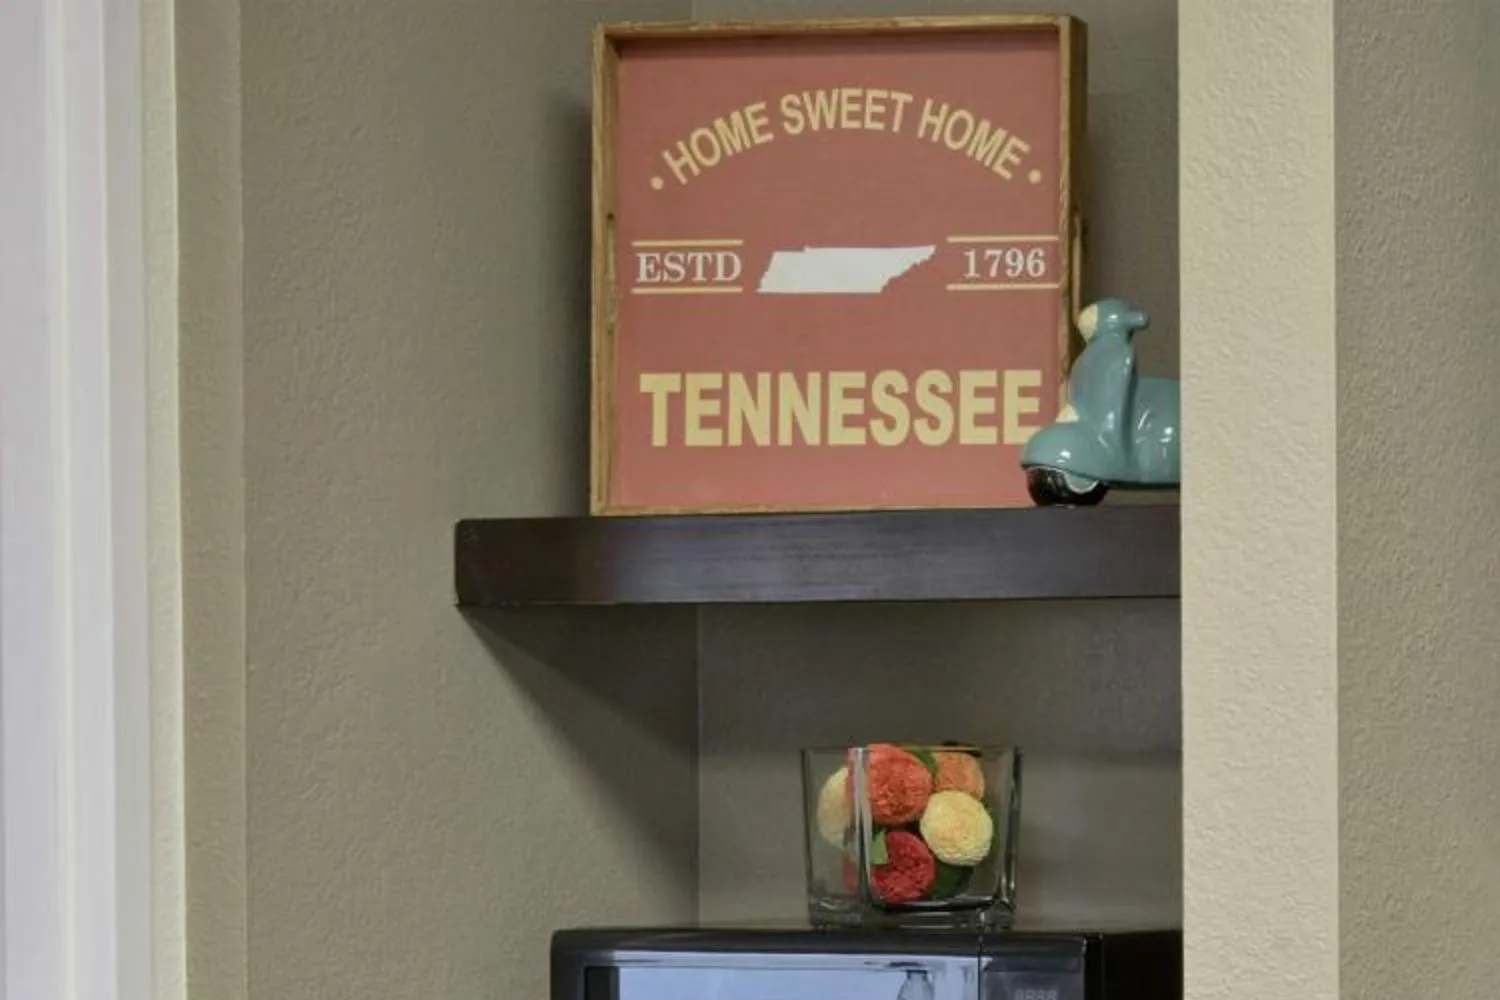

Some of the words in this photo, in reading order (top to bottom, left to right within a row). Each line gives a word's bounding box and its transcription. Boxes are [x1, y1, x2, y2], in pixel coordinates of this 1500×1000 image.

[662, 101, 774, 186] HOME
[779, 87, 913, 137] SWEET
[917, 97, 1030, 181] HOME
[635, 251, 742, 284] ESTD
[962, 247, 1047, 280] 1796
[639, 368, 1043, 448] TENNESSEE
